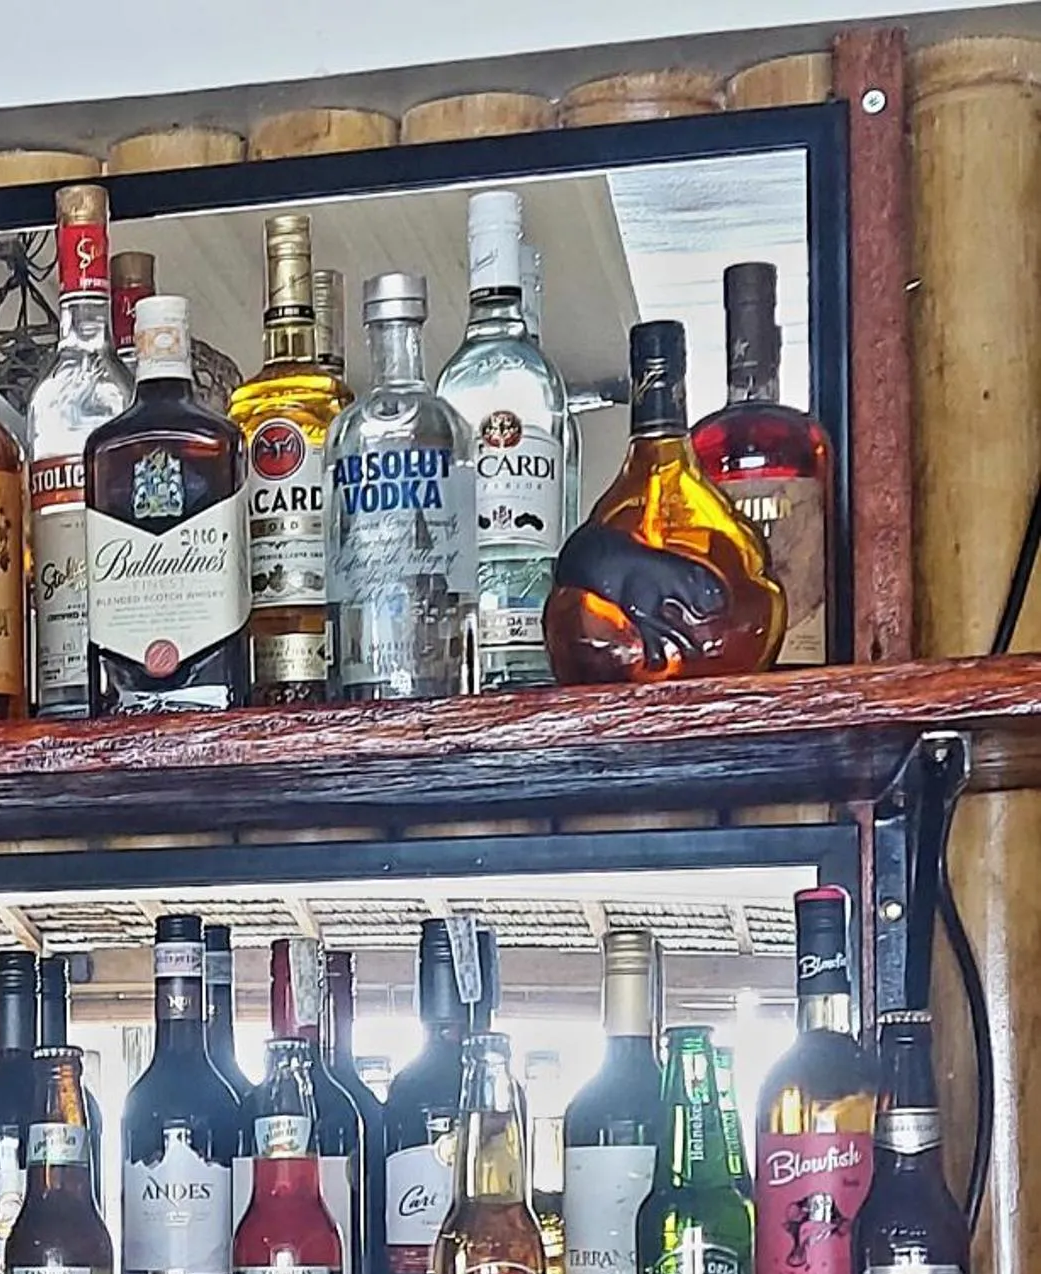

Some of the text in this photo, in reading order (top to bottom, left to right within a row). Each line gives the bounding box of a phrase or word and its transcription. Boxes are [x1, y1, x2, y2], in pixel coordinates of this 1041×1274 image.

[332, 447, 453, 488] ABSOLUT
[343, 480, 443, 515] VODKA
[92, 537, 228, 583] Ballantine's
[766, 1140, 863, 1187] Blowfish
